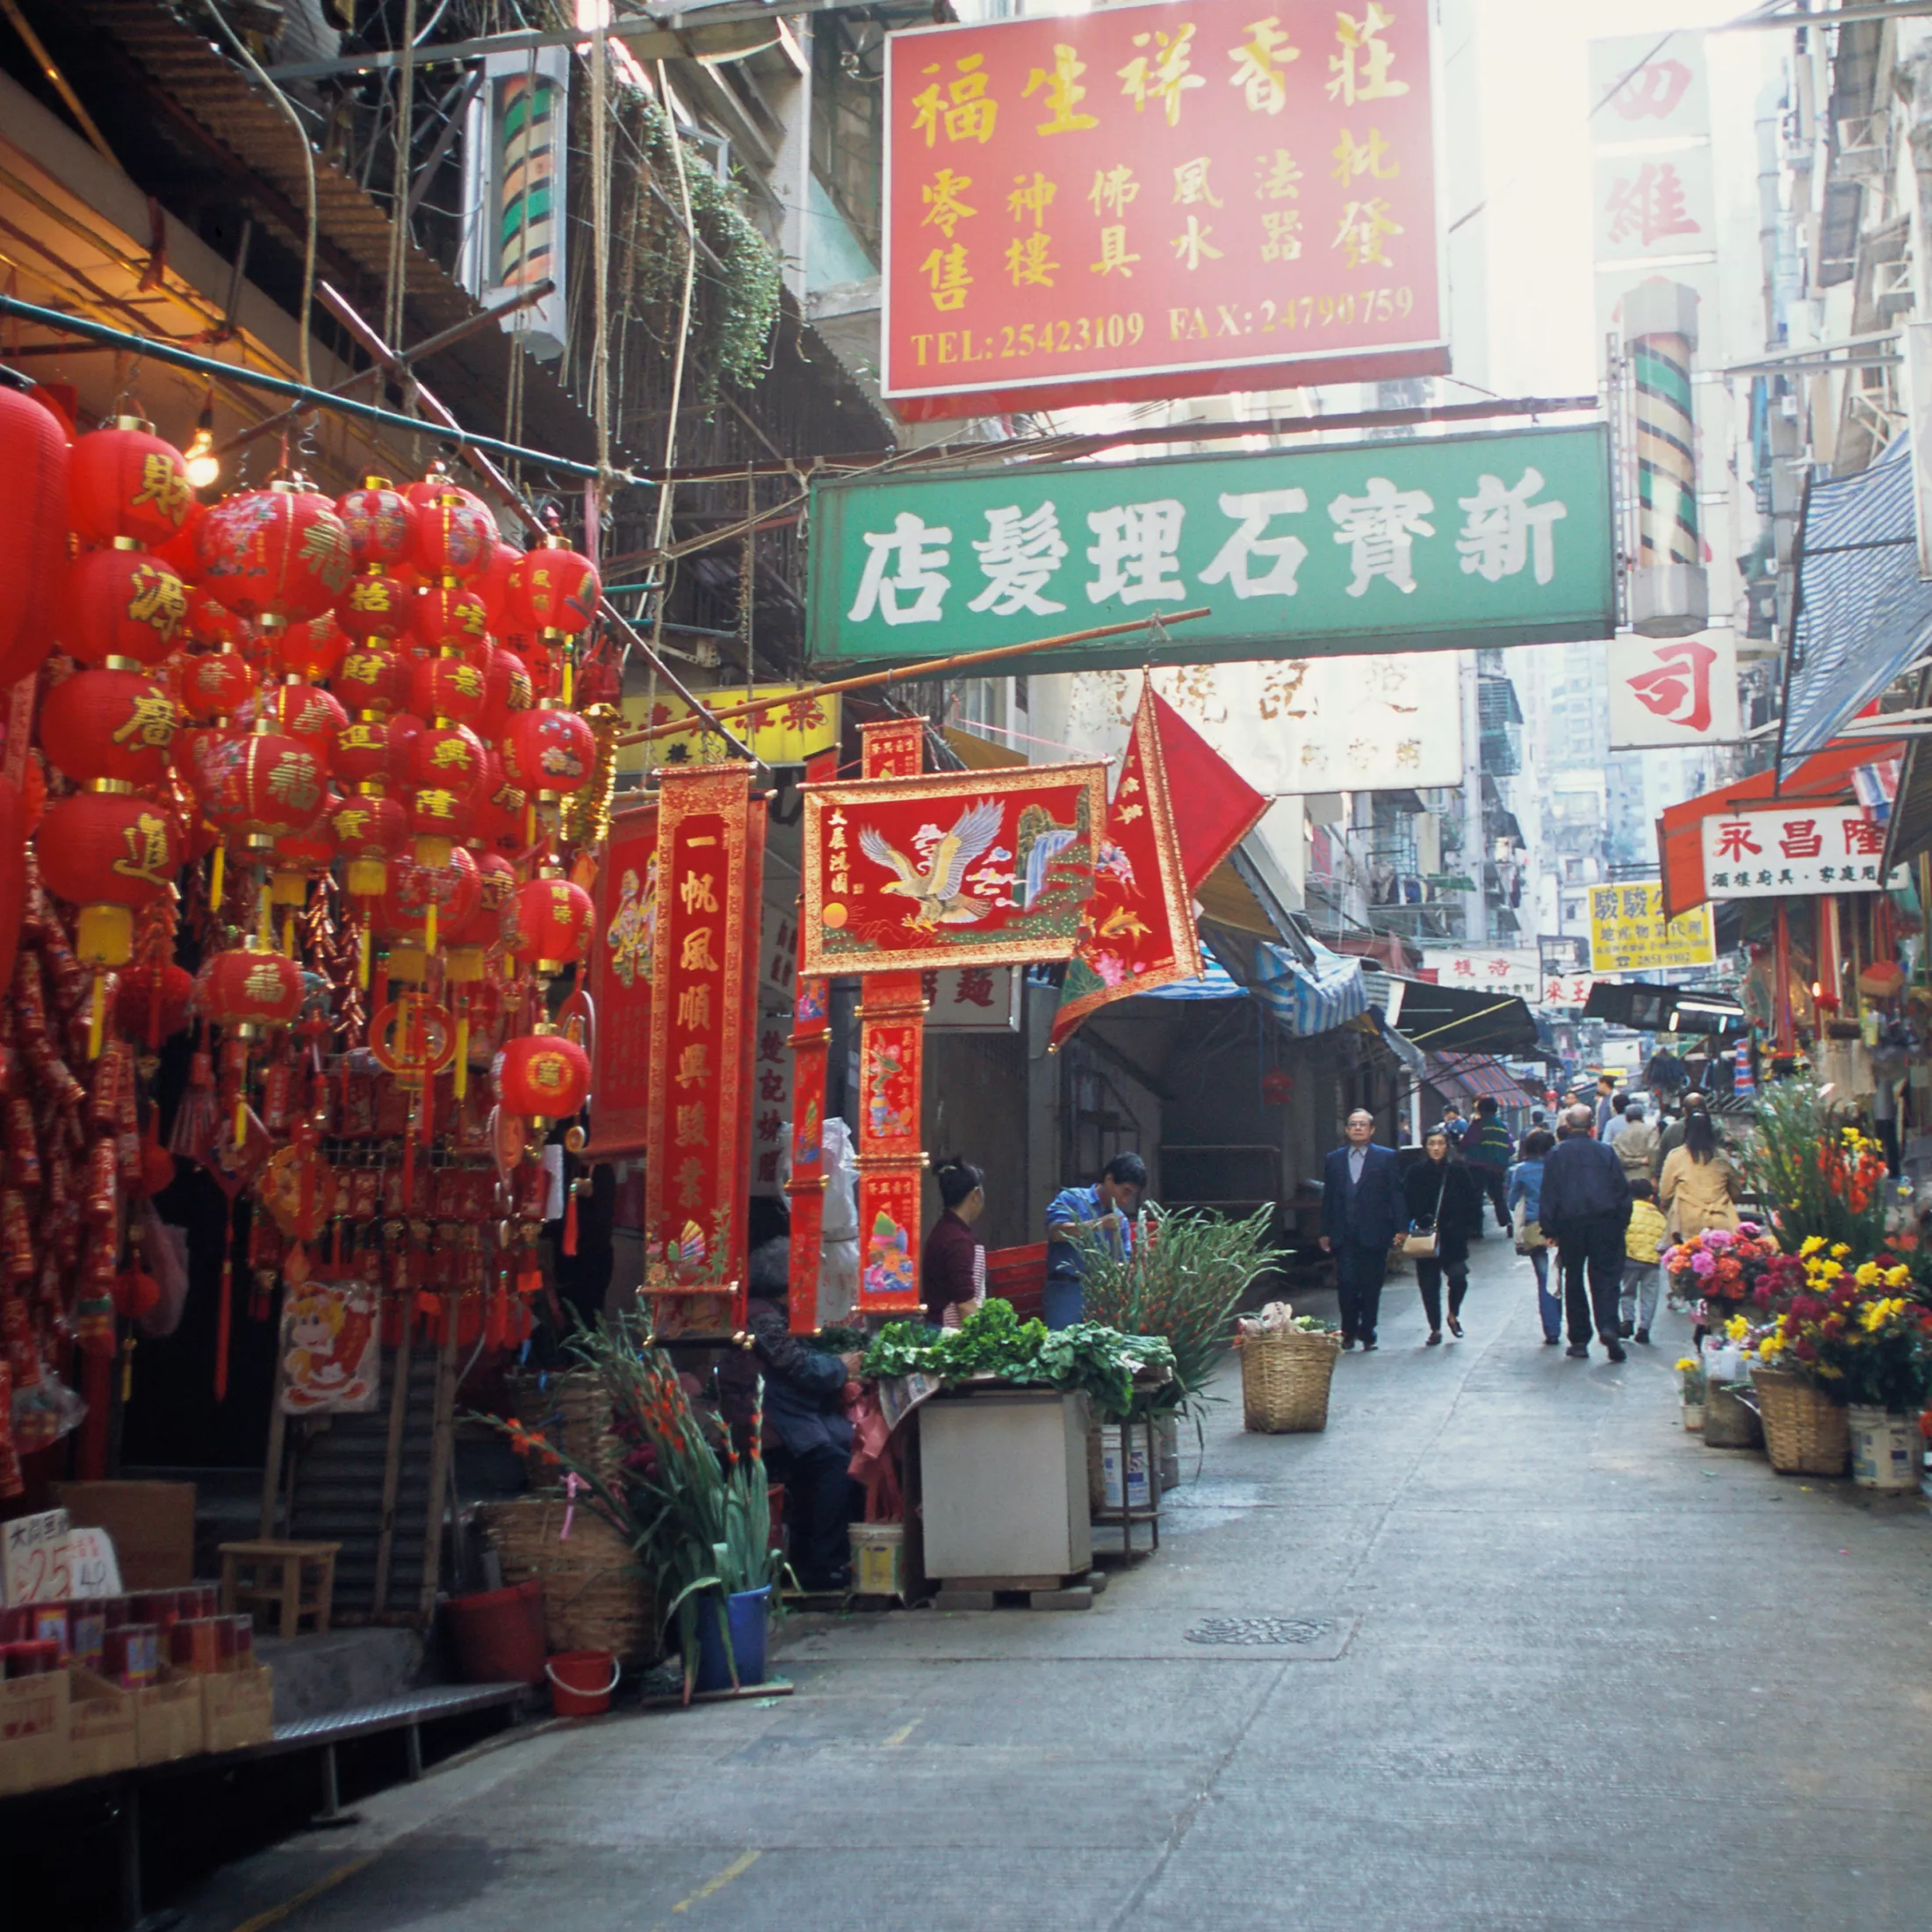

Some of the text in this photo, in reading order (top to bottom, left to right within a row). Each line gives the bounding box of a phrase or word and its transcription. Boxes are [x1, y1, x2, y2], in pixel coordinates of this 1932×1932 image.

[911, 3, 1410, 148] 福生祥香莊
[919, 168, 977, 312] 零售
[1087, 162, 1141, 278] 佛具
[1170, 155, 1225, 271] 風水
[1253, 148, 1304, 263] 法器
[1329, 126, 1405, 270] 批發
[1626, 642, 1717, 732] 司
